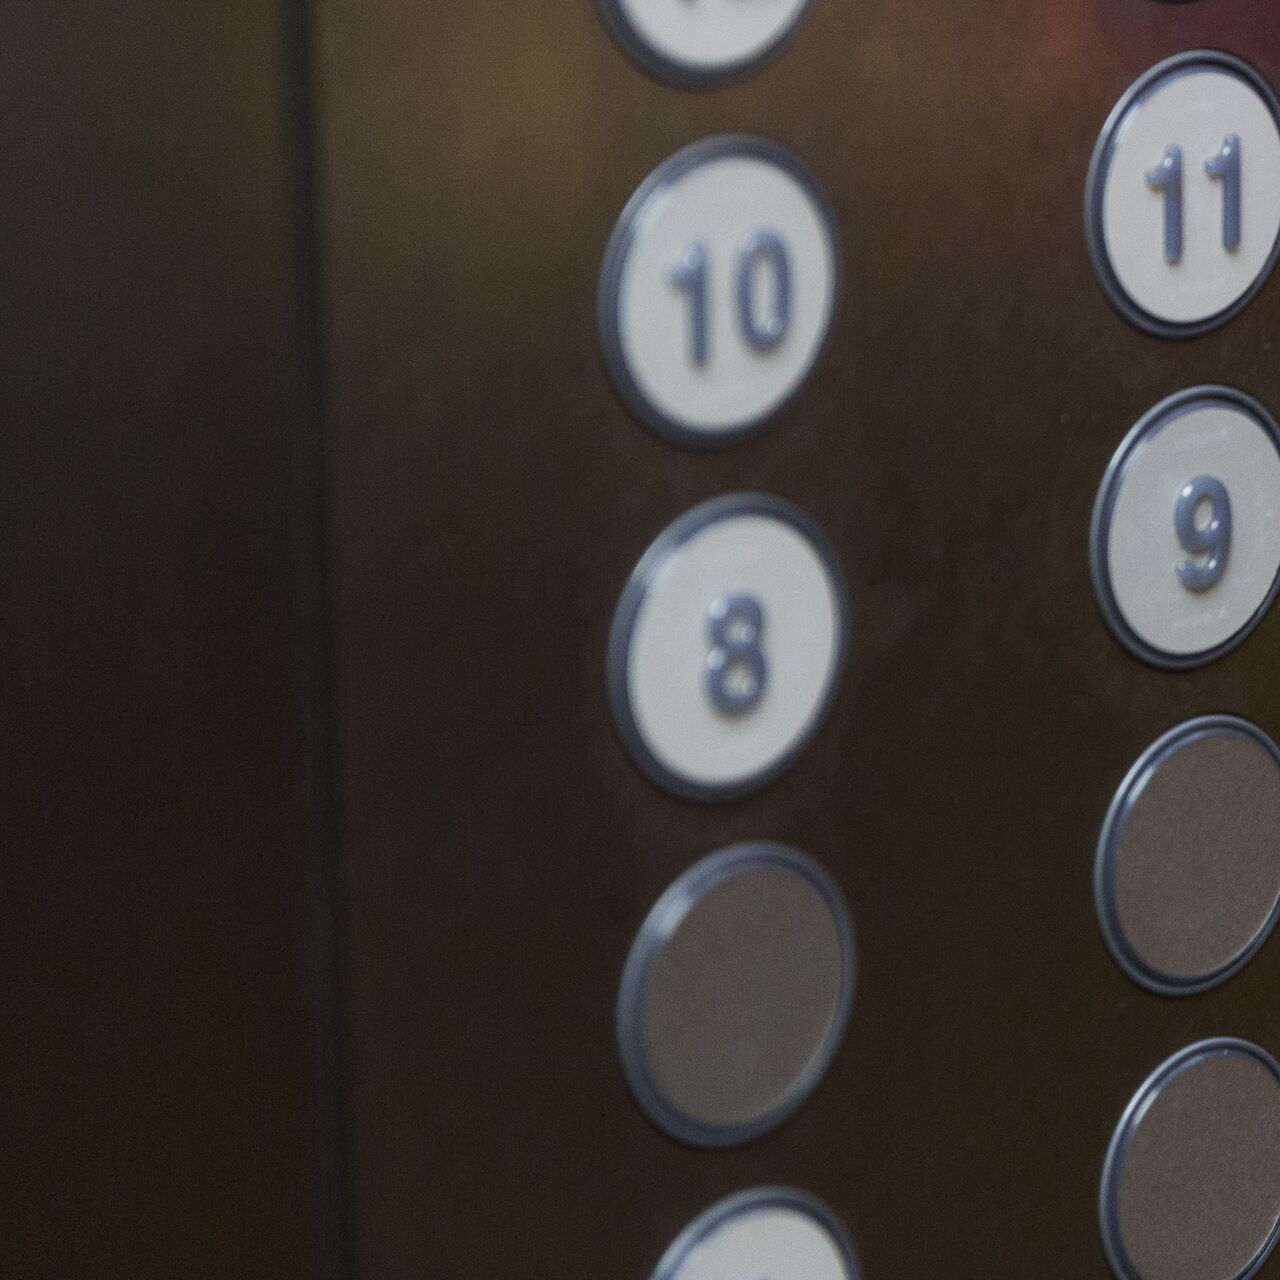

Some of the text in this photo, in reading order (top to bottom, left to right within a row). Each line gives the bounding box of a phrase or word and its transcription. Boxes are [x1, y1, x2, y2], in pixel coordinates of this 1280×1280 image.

[1144, 132, 1242, 267] 11
[669, 228, 793, 369] 10
[1173, 472, 1234, 593] 9
[703, 592, 771, 719] 8
